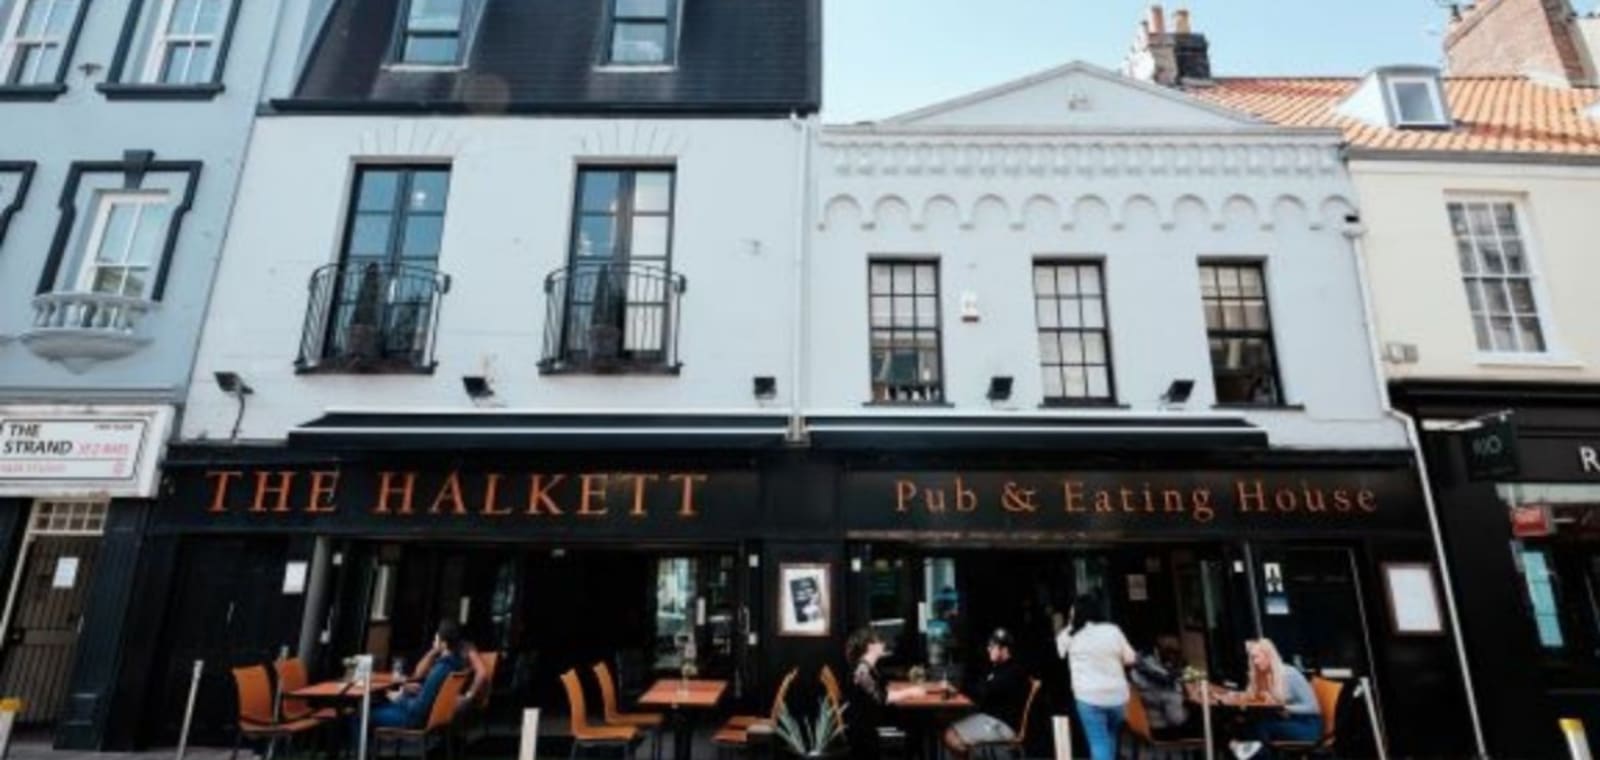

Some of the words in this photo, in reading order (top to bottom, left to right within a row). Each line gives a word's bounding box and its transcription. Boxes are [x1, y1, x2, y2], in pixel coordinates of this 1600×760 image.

[9, 424, 41, 436] THE
[3, 440, 73, 454] STRAND
[206, 471, 340, 512] THE
[375, 472, 708, 516] HALKETT
[895, 477, 978, 513] Pub
[1001, 481, 1037, 512] &
[1063, 479, 1214, 520] Eating
[1235, 479, 1378, 512] House
